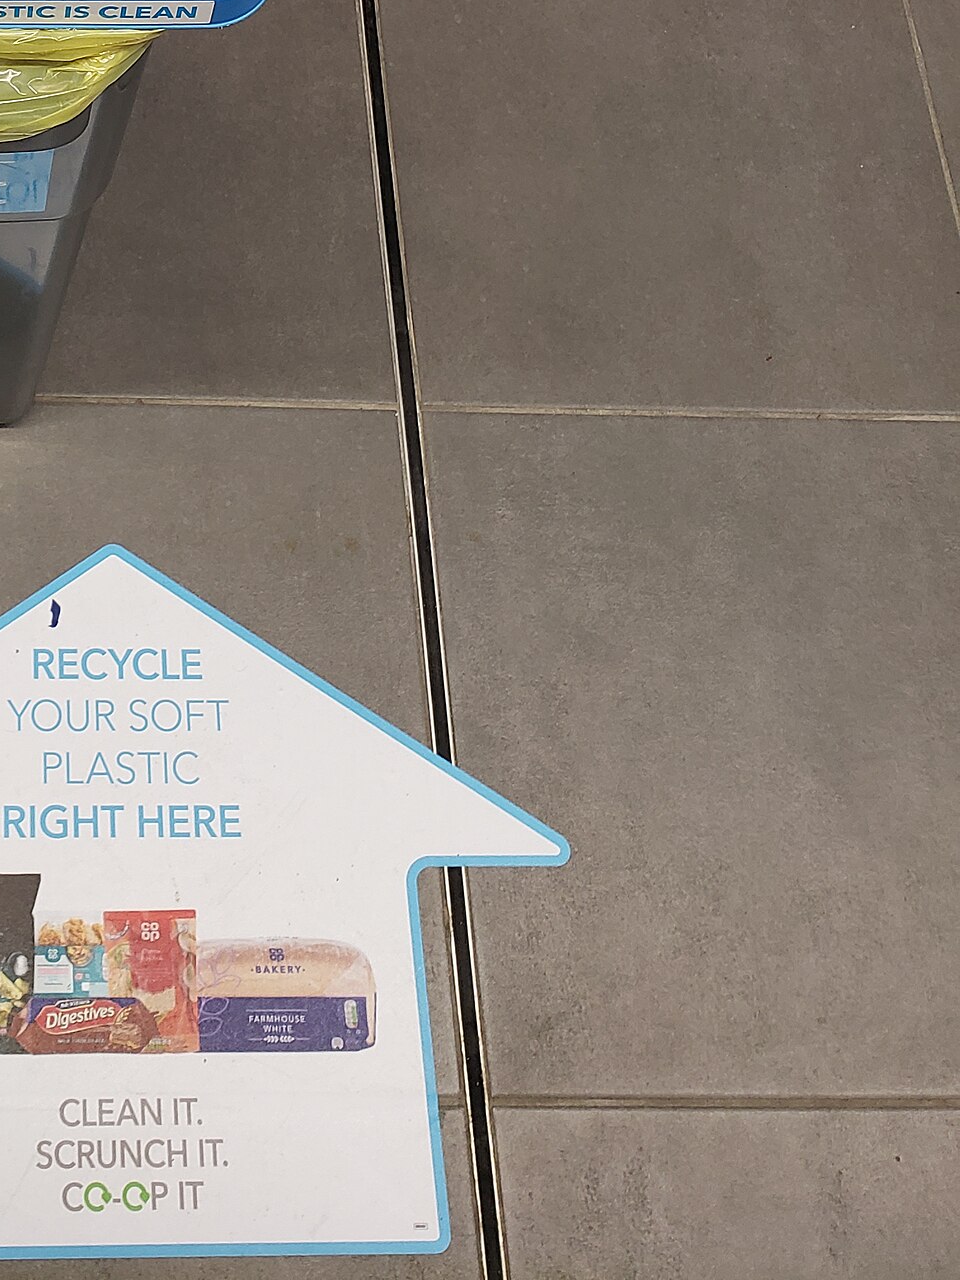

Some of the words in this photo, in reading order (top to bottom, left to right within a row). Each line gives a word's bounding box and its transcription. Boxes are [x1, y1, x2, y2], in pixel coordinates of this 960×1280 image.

[64, 6, 90, 19] IS
[98, 6, 198, 19] CLEAN
[32, 648, 203, 681] RECYCLE
[7, 699, 117, 732] YOUR
[129, 699, 230, 732] SOFT
[43, 751, 200, 785] PLASTIC
[3, 804, 125, 839] RIGHT
[137, 805, 242, 838] HERE
[46, 1007, 115, 1029] Digestives
[248, 1015, 306, 1023] FARMHOUSE
[263, 1025, 293, 1033] WHITE
[58, 1097, 162, 1128] CLEAN
[173, 1097, 204, 1126] IT.
[36, 1138, 188, 1170] SCRUNCH
[199, 1138, 230, 1168] IT.
[61, 1180, 169, 1213] CO-OP
[179, 1180, 205, 1211] IT
